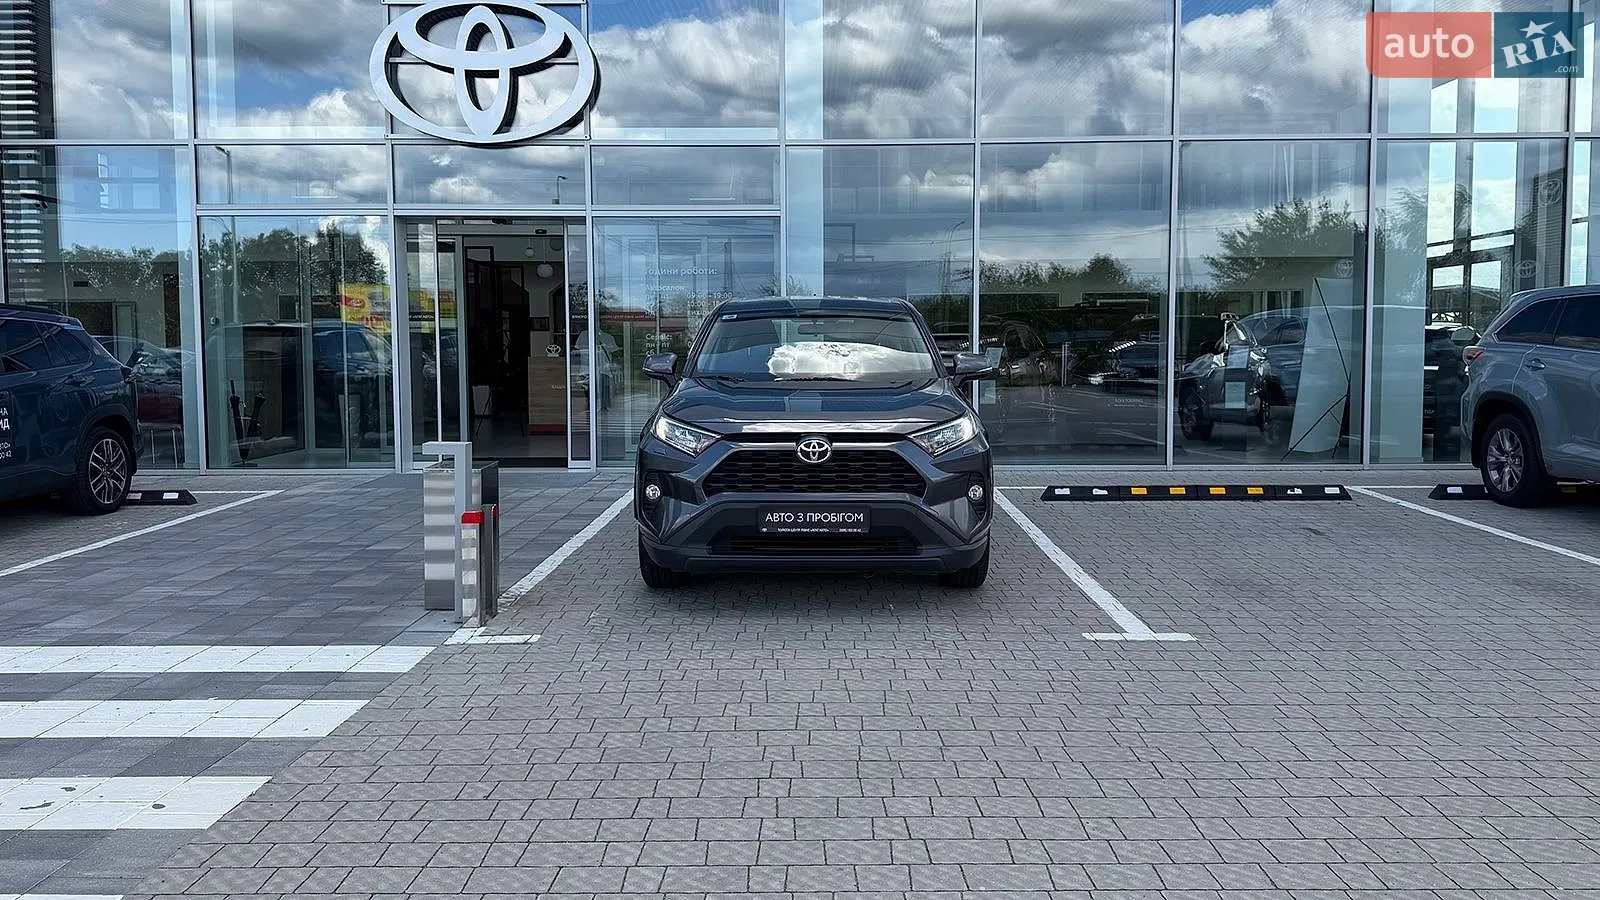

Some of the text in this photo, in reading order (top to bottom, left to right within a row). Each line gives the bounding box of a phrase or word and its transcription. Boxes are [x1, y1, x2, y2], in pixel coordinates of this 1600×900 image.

[644, 266, 718, 277] одини роботи:
[765, 512, 795, 522] АВТО
[806, 512, 864, 522] ПРОБІГОМ
